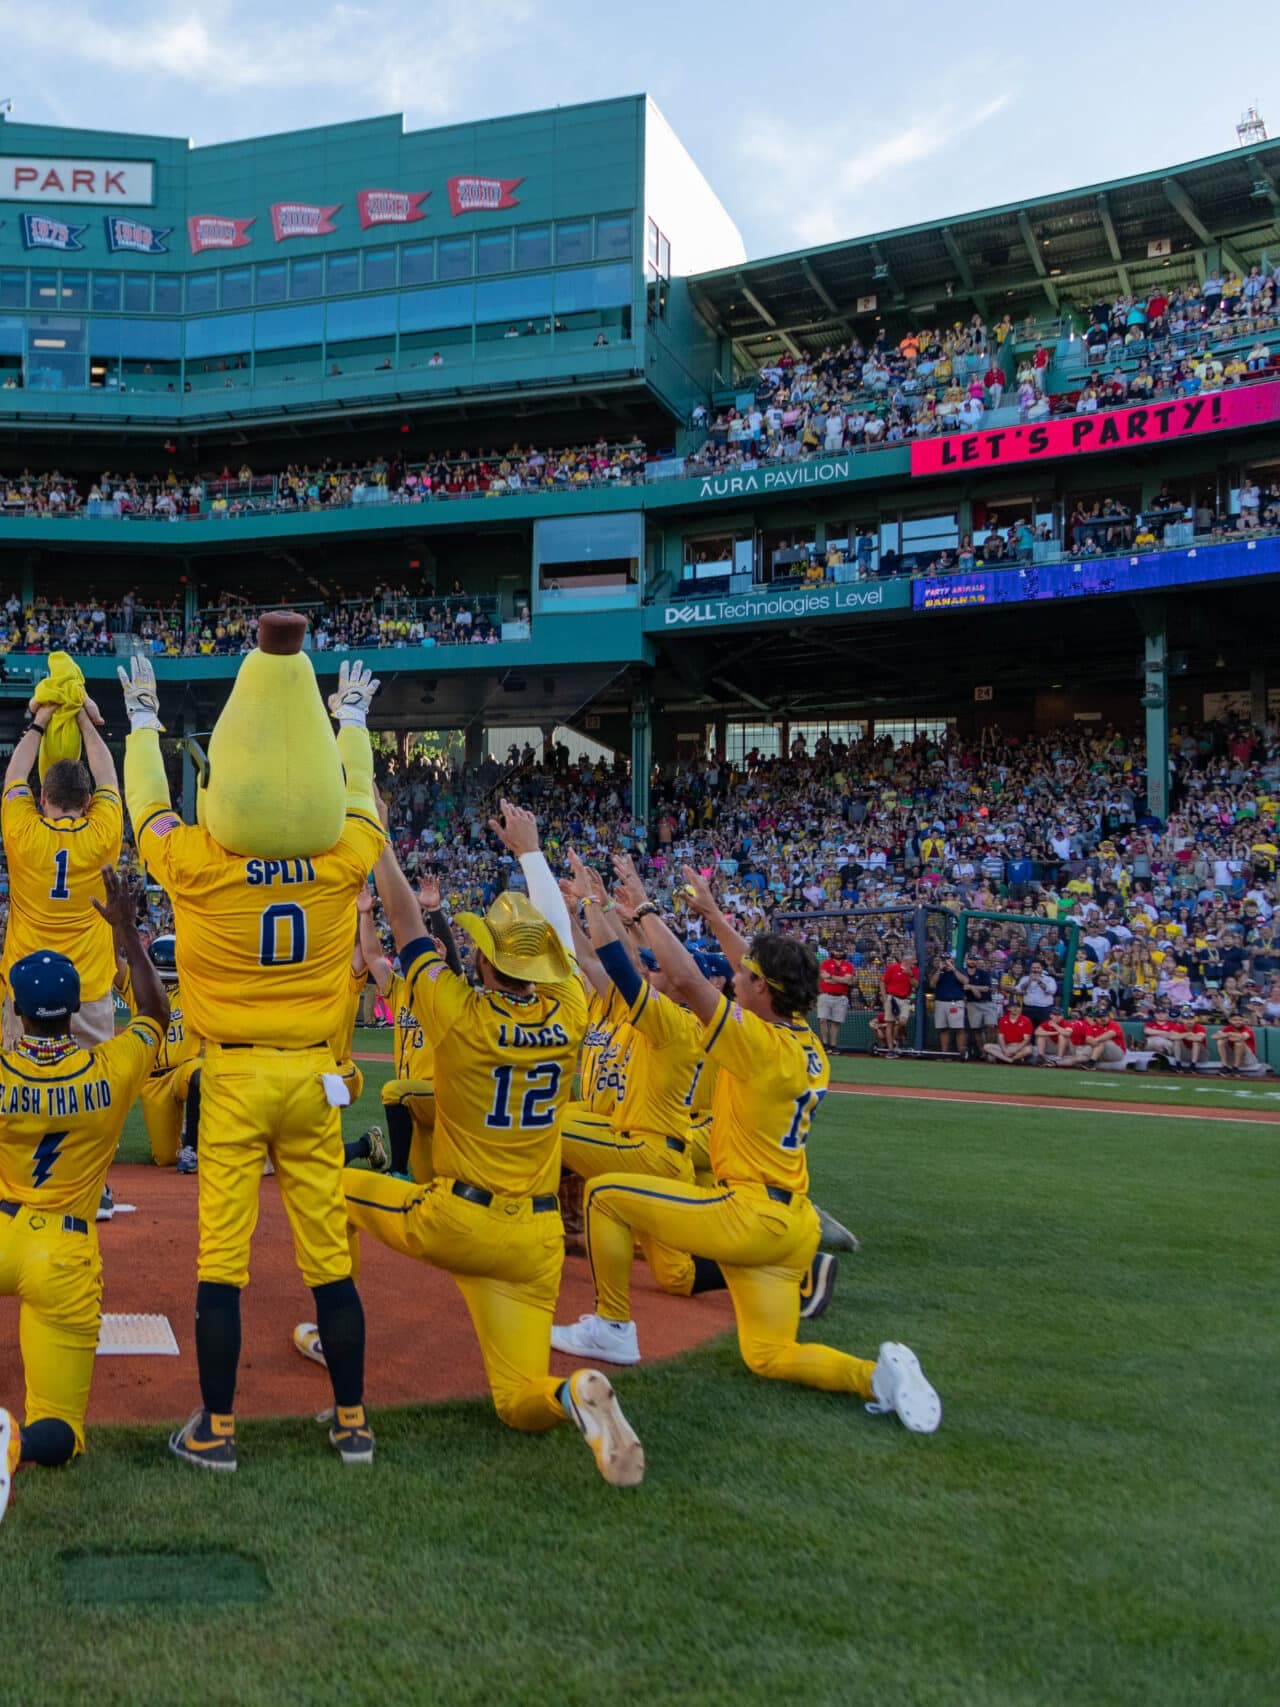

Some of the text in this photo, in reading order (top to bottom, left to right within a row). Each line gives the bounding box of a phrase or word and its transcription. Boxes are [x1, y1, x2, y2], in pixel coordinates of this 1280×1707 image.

[14, 167, 127, 195] PARK
[458, 184, 502, 202] 2018
[280, 211, 321, 229] 2007
[941, 396, 1223, 466] LET'S PARTY!
[764, 461, 849, 489] PAVILION
[664, 586, 883, 625] DELL Technologies Level
[49, 848, 70, 899] 1
[258, 901, 307, 967] 0
[46, 1084, 79, 1117] THA
[83, 1079, 112, 1112] KID
[485, 1060, 563, 1129] 12
